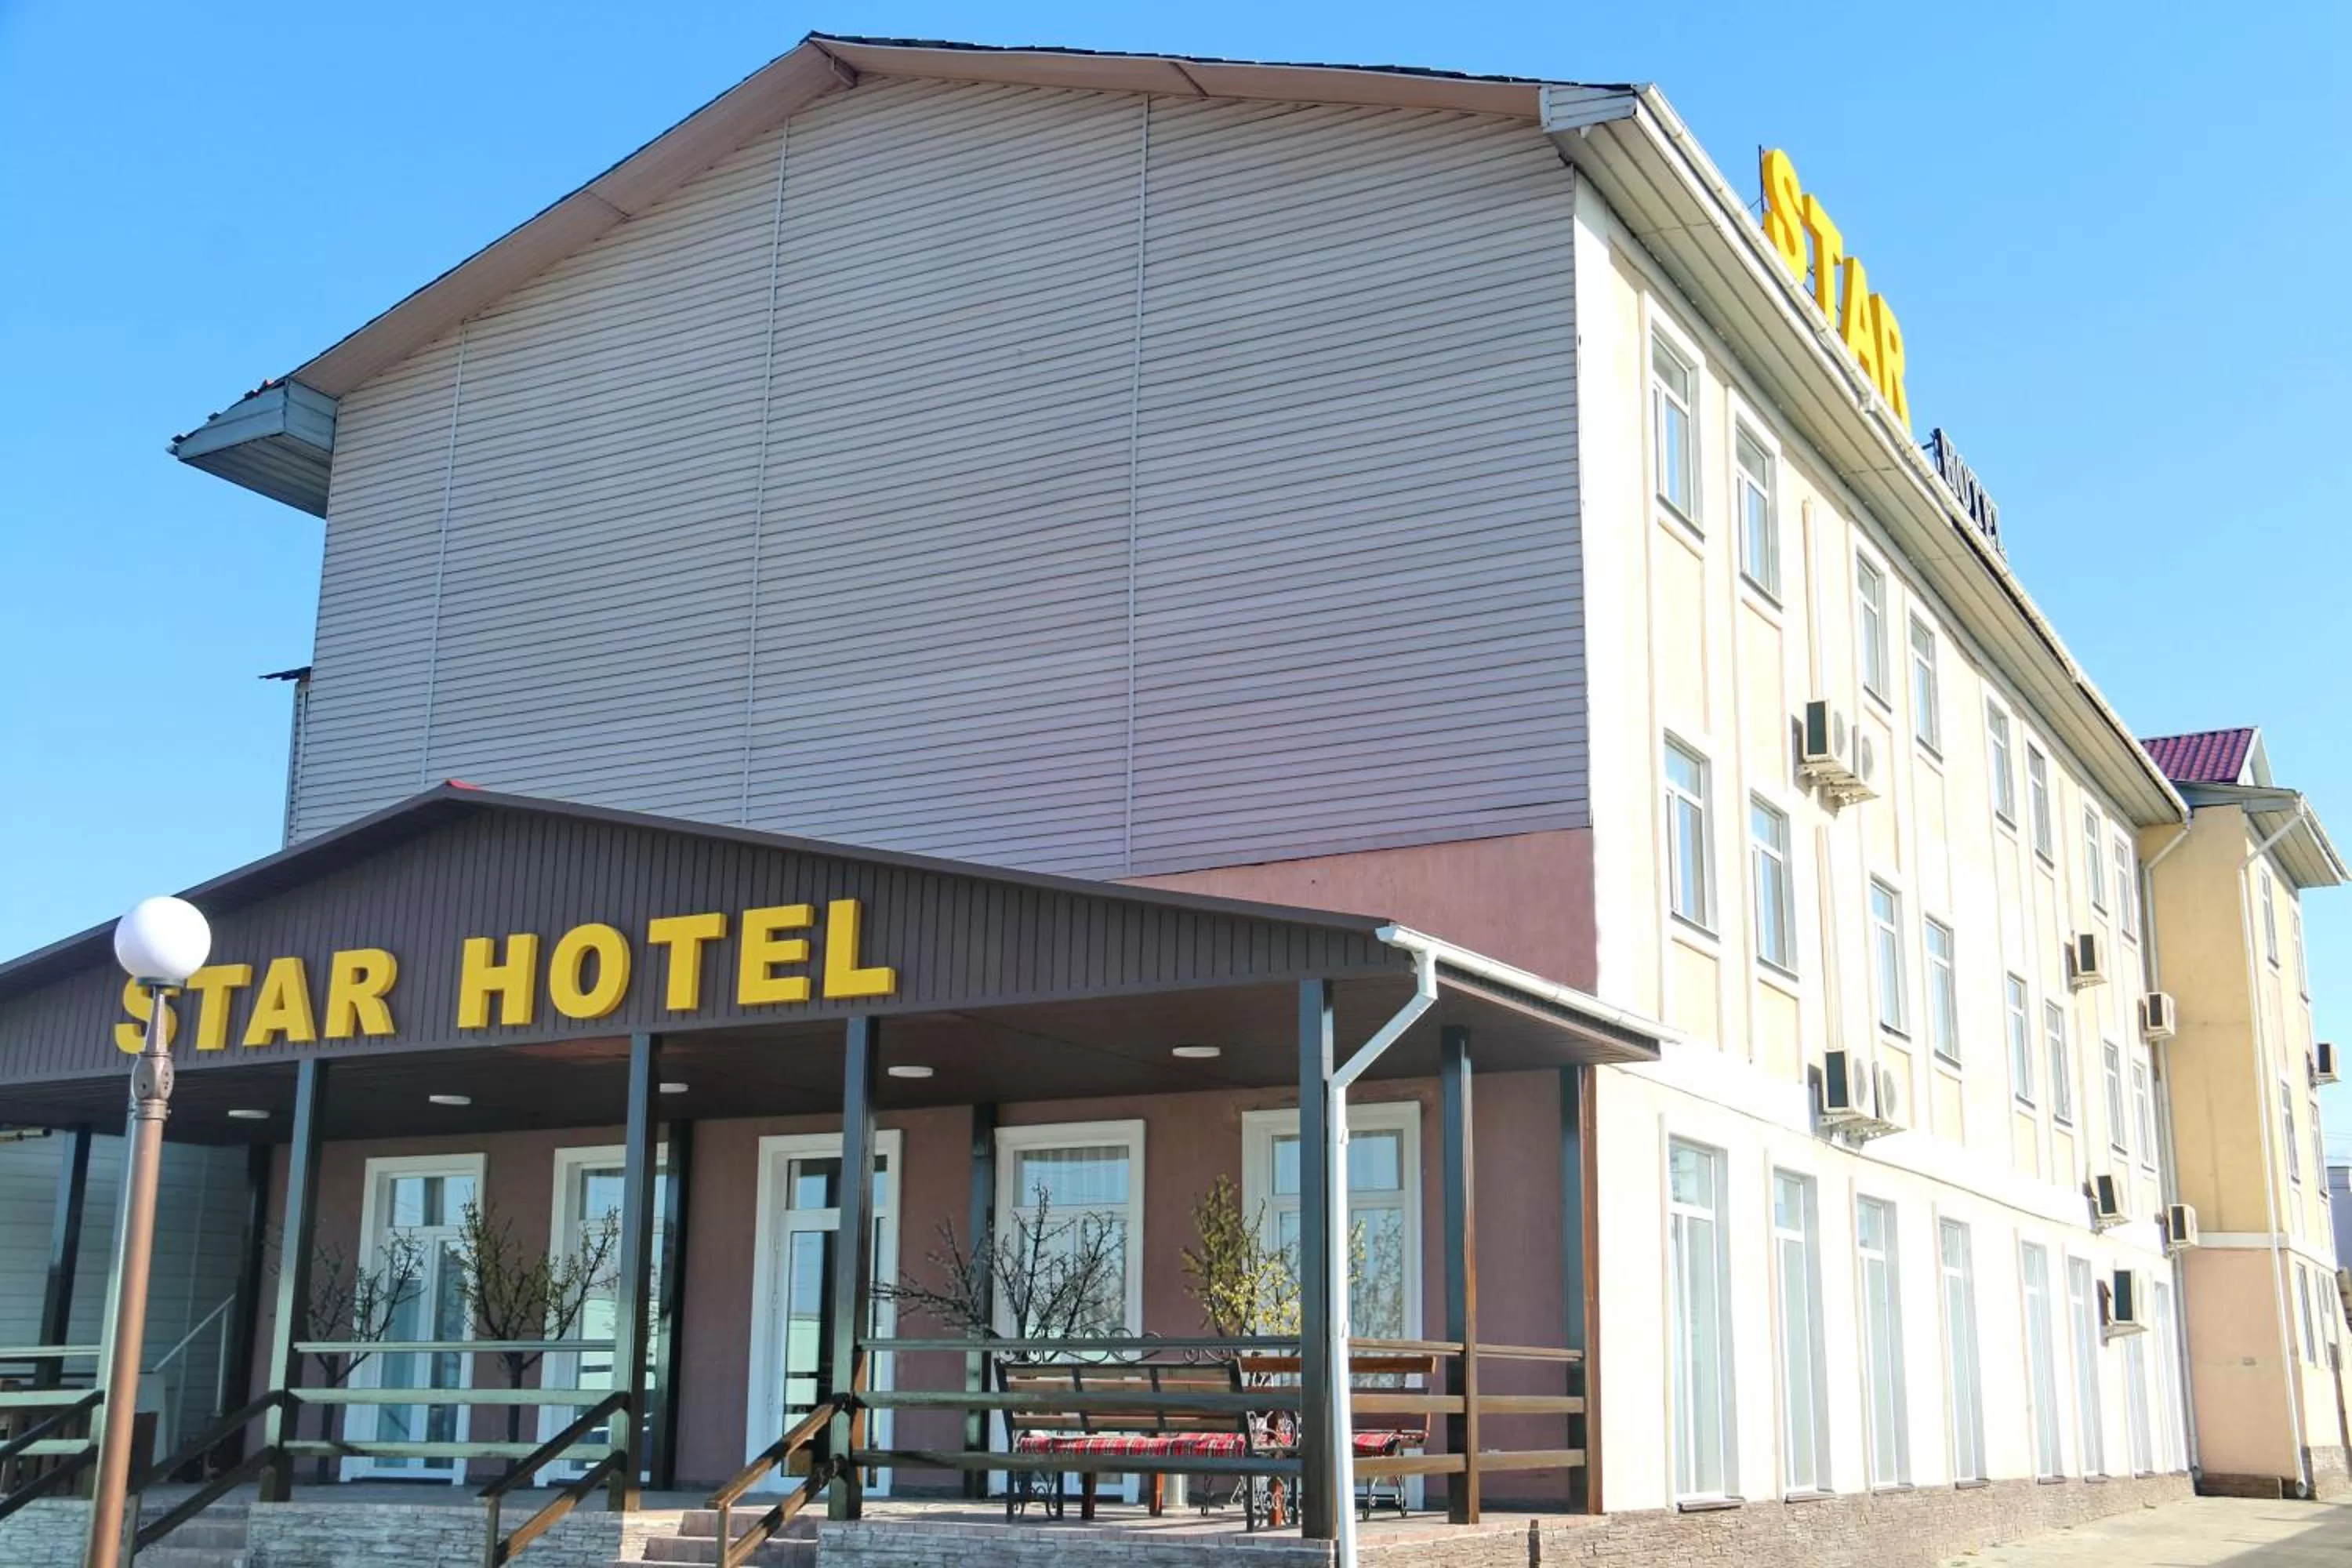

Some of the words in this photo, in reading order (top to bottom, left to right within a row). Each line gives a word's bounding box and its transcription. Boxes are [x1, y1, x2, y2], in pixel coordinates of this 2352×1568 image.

[1763, 147, 1911, 437] STAR
[114, 947, 397, 1054] STAR
[458, 898, 895, 1029] HOTEL
